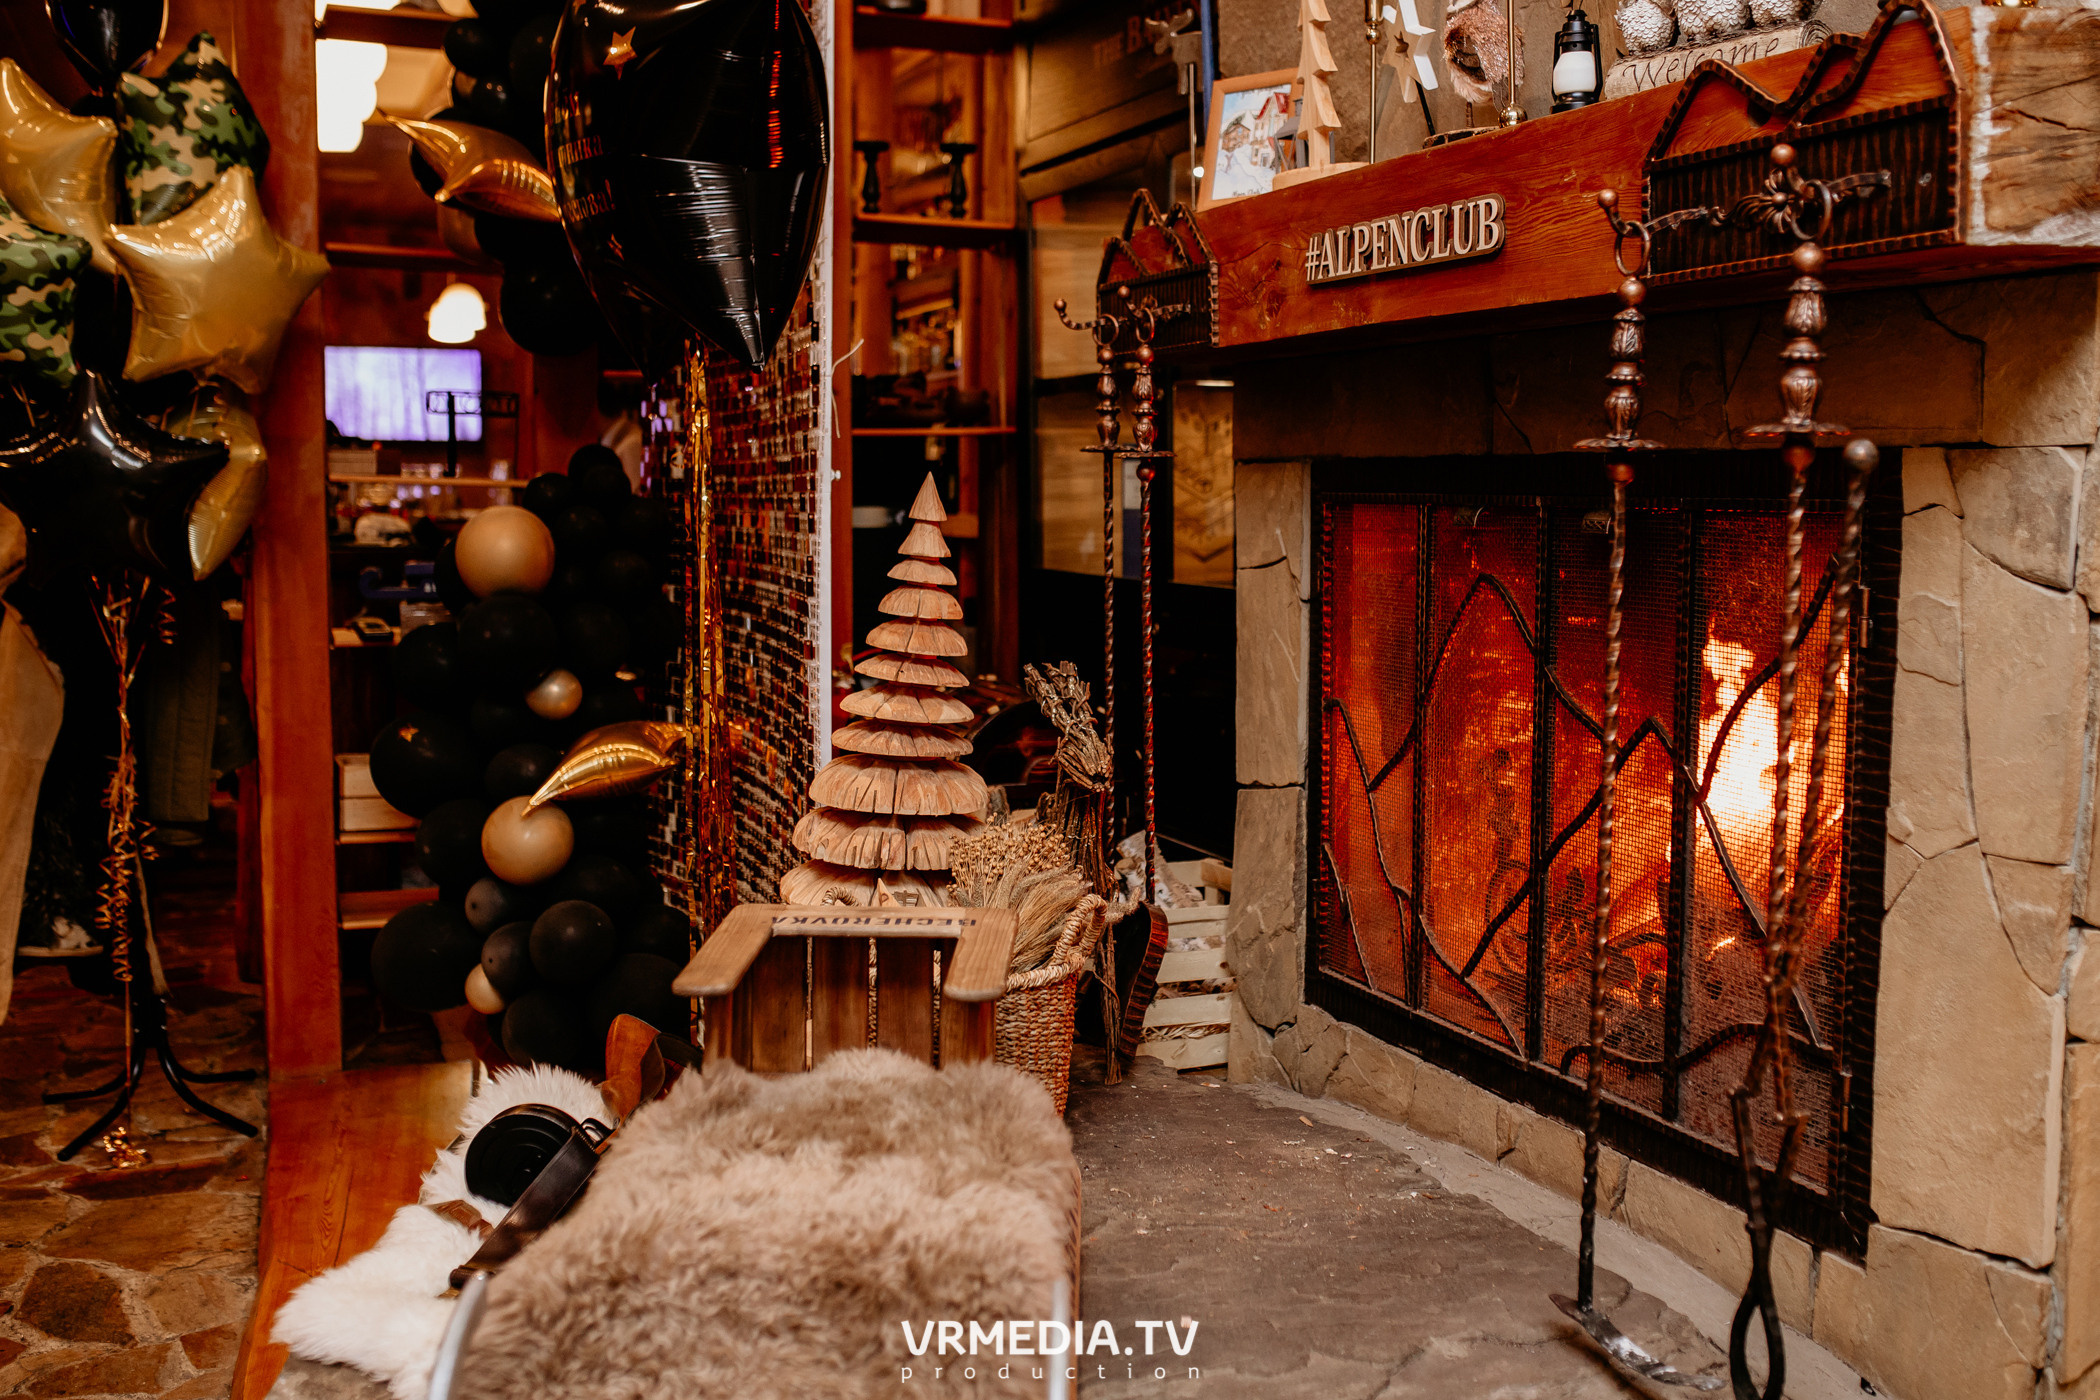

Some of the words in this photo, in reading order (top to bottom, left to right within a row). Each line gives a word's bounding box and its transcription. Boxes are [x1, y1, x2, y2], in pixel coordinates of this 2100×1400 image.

[1622, 37, 1780, 92] Welcome
[1305, 197, 1502, 282] #ALPENCLUB
[772, 915, 977, 927] BECHEROVKA
